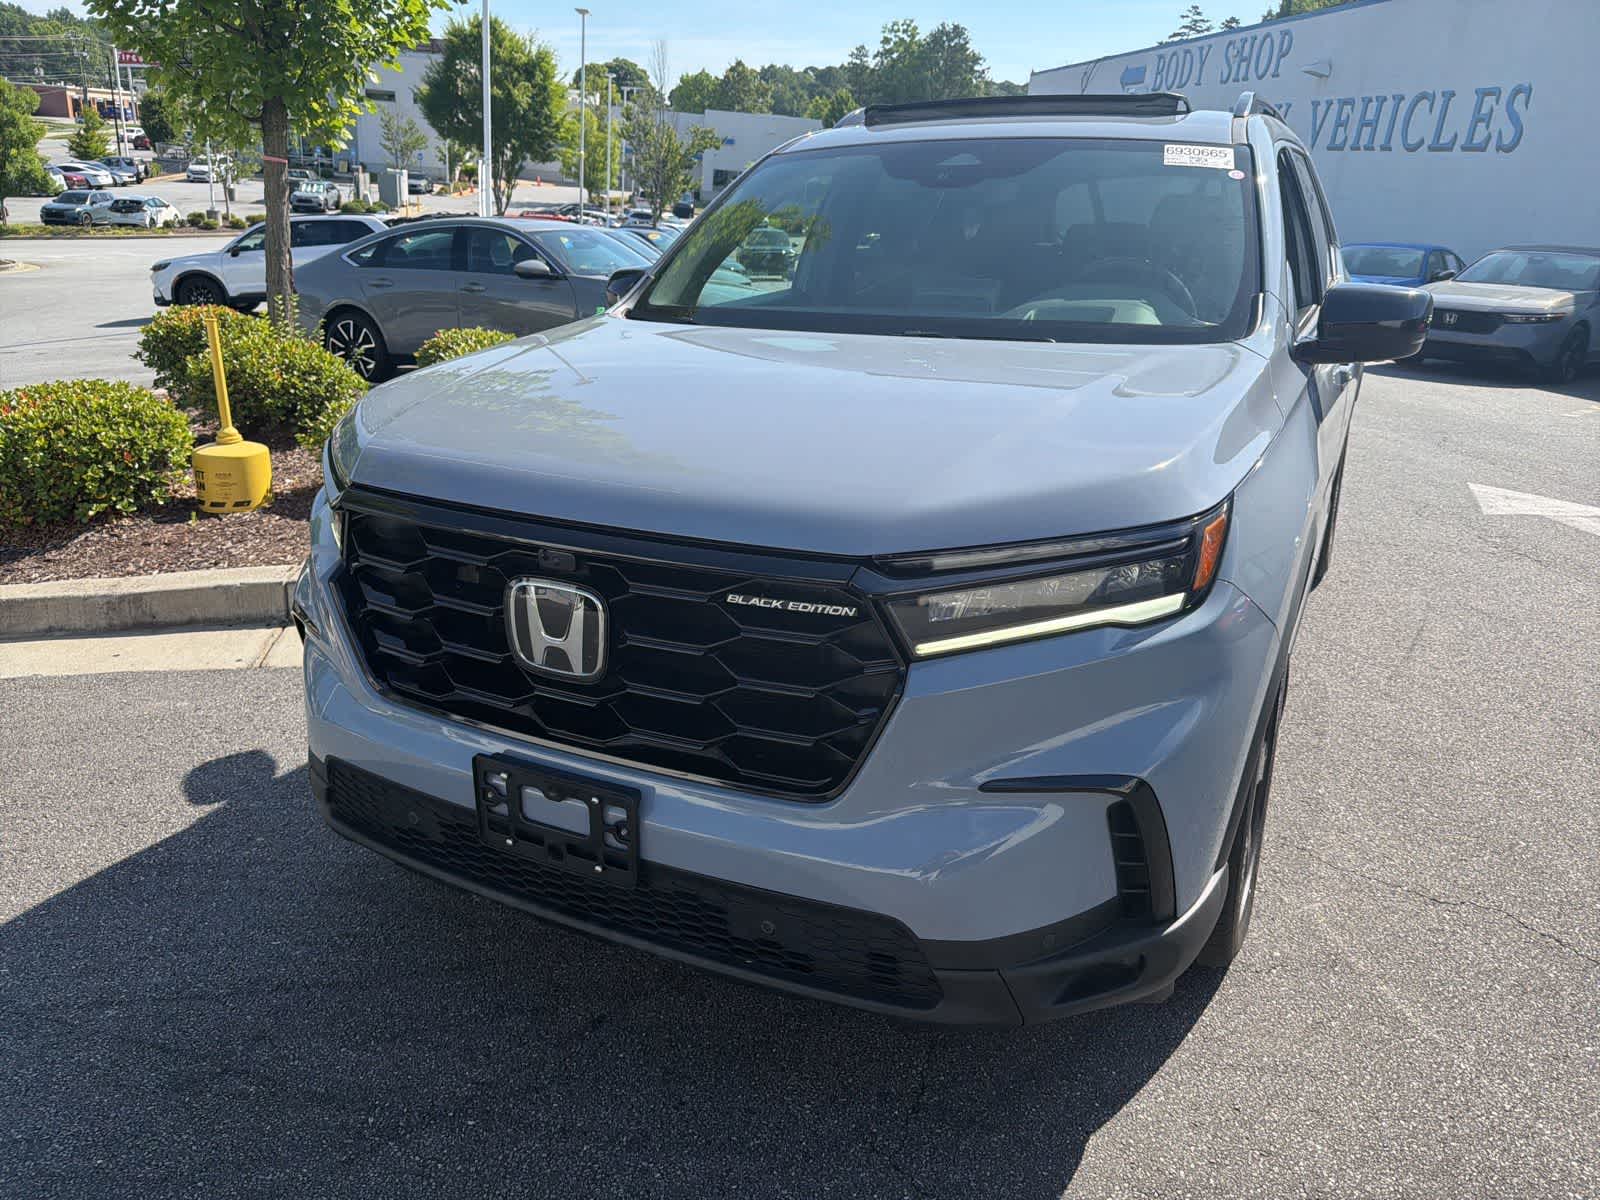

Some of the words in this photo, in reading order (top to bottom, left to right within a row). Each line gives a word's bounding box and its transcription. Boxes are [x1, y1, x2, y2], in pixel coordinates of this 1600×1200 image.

[1151, 44, 1213, 92] BODY
[1219, 28, 1294, 85] SHOP
[1310, 81, 1534, 154] VEHICLES
[1166, 146, 1228, 158] 6930665
[726, 593, 785, 610] BLACK
[787, 601, 858, 617] EDITION
